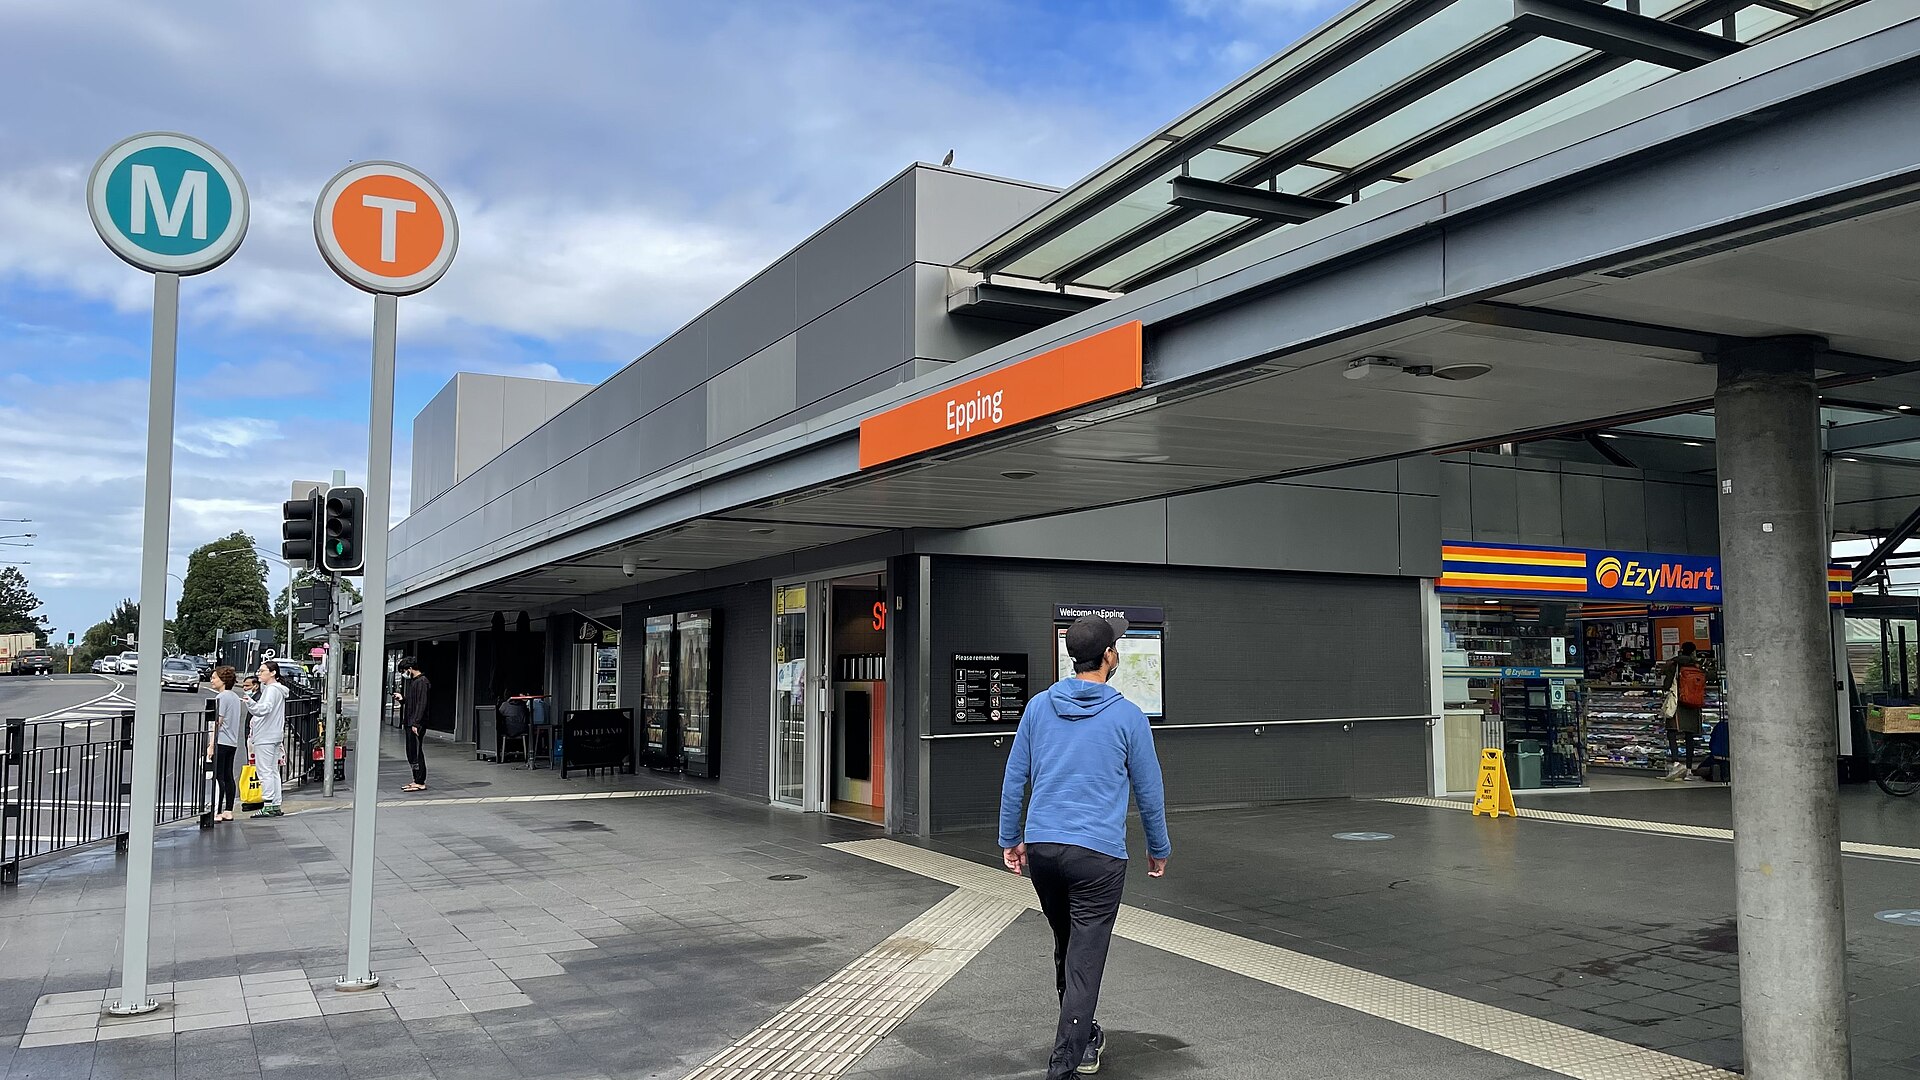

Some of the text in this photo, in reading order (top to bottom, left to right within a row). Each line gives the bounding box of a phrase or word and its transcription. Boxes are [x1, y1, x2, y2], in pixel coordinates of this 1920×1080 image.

[130, 164, 208, 240] M
[362, 194, 417, 263] T
[946, 389, 1004, 436] Epping
[1621, 561, 1714, 595] EzyMart
[1059, 607, 1092, 617] Welcome
[1101, 609, 1125, 619] Epping
